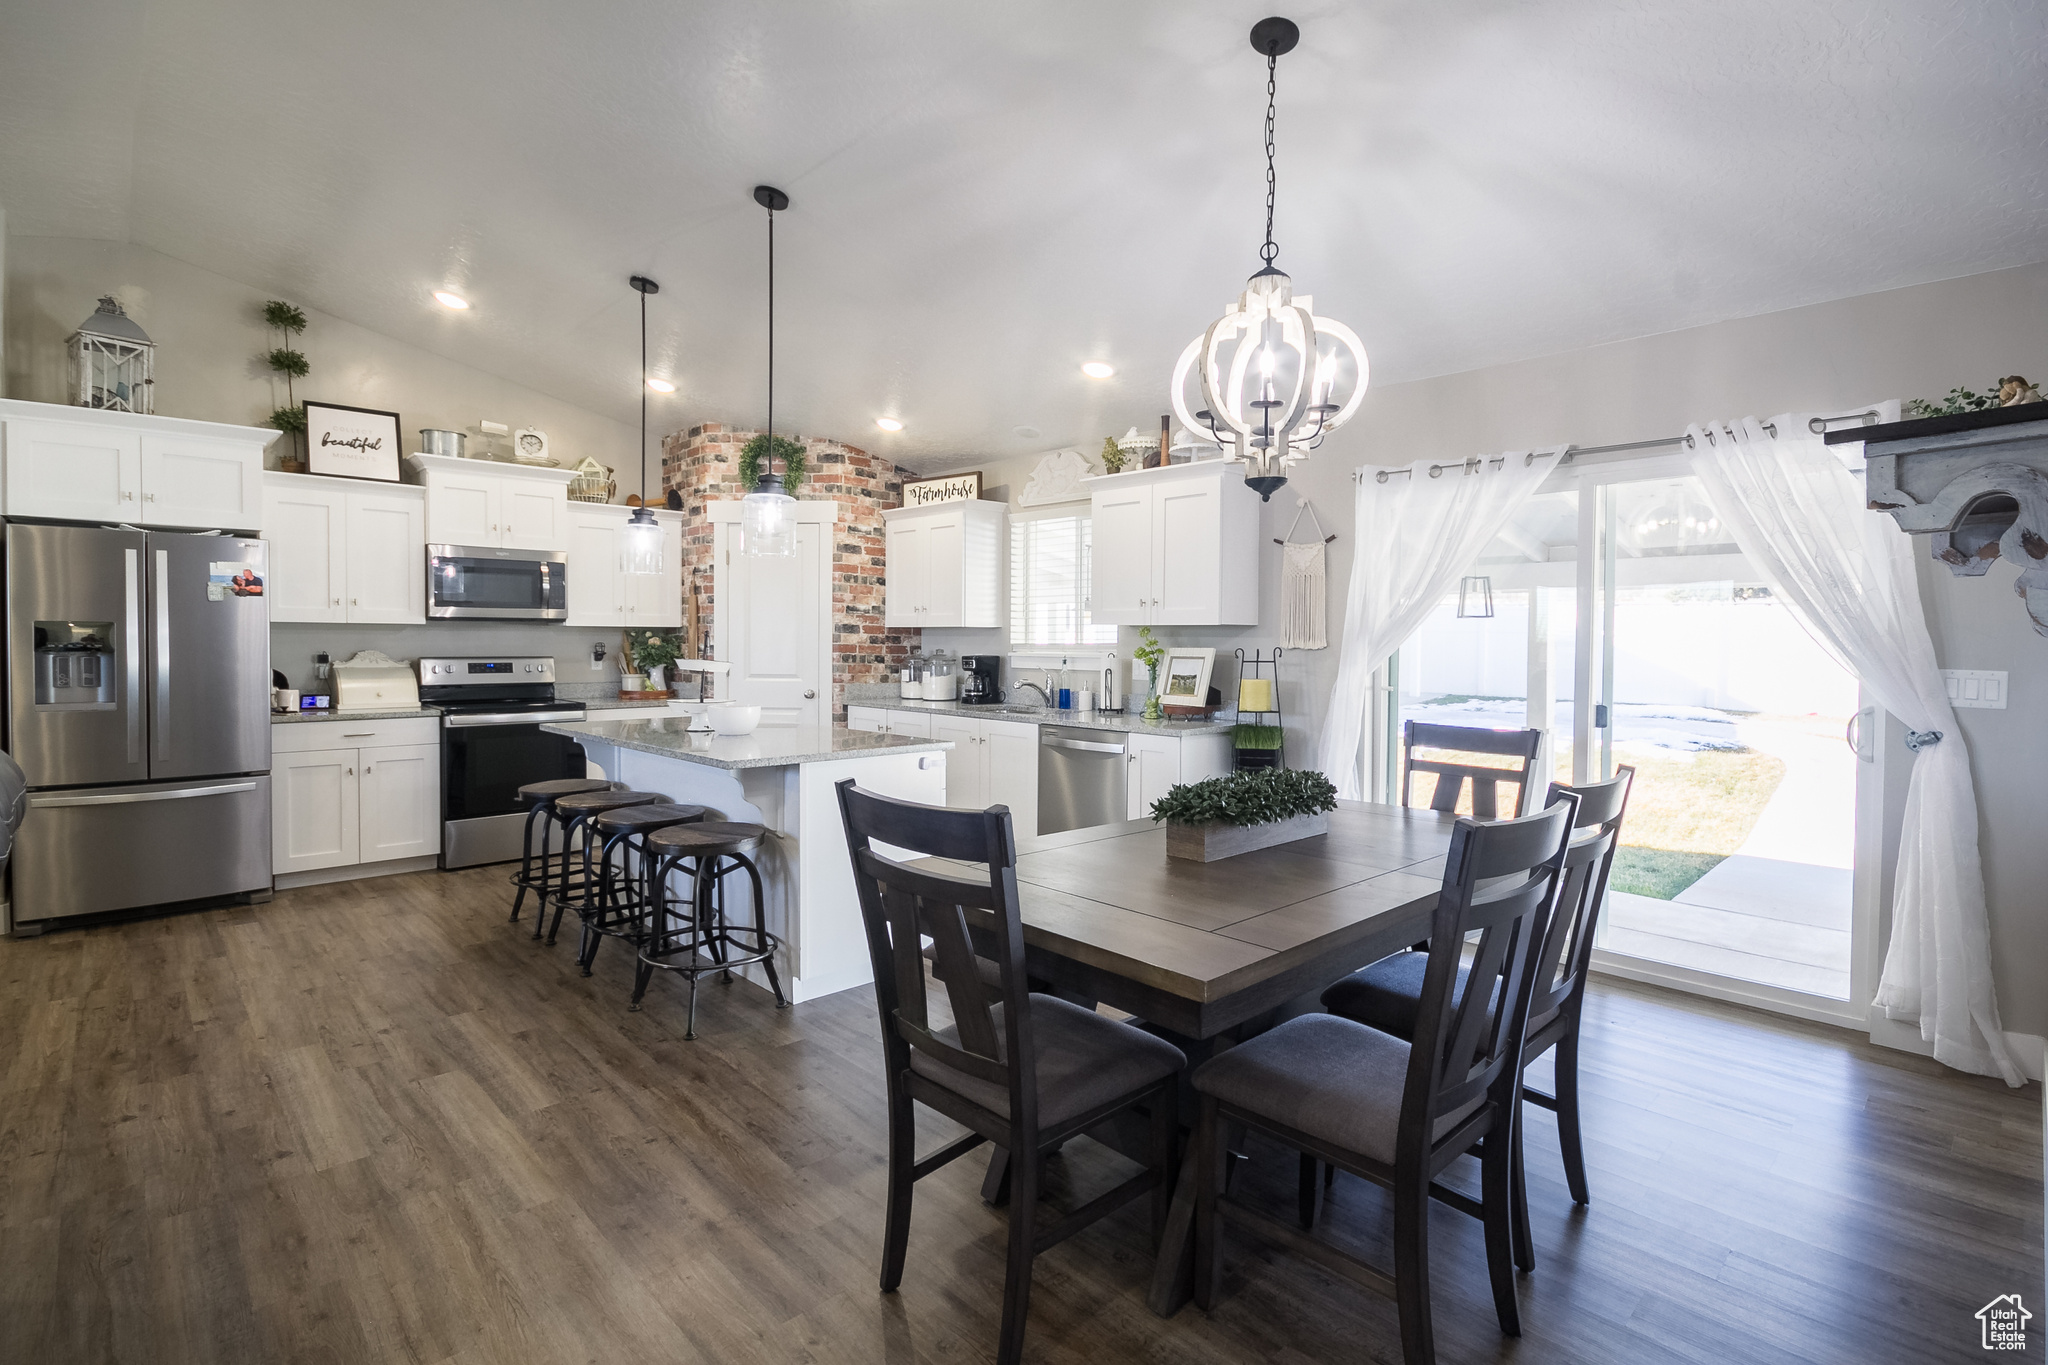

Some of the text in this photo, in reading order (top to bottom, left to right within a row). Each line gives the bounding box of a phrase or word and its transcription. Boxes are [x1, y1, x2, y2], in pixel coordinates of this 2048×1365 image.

[332, 425, 373, 435] COLLECT
[321, 431, 382, 453] beautiful
[332, 452, 377, 462] MOMENTS
[909, 479, 975, 505] Farmhouse
